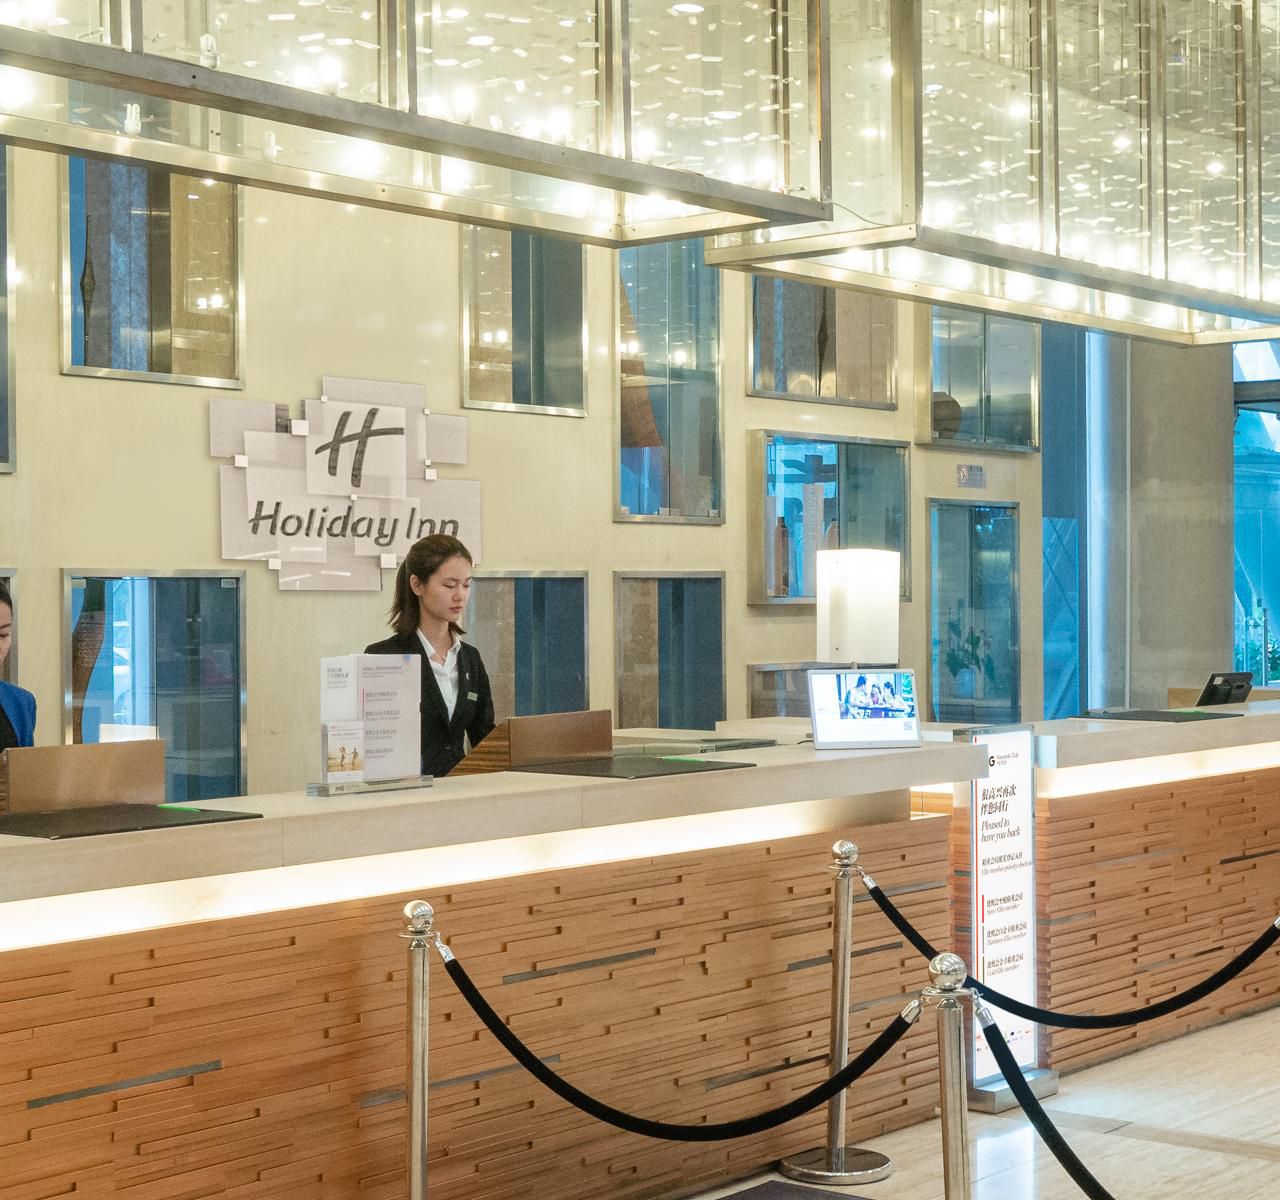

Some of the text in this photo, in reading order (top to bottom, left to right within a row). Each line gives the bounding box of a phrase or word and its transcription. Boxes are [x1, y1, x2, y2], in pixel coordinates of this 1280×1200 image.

[315, 407, 404, 488] H
[248, 500, 459, 547] Holiday Inn
[982, 784, 1016, 801] 很高兴再次
[981, 800, 1009, 815] 伴您同行
[981, 818, 1010, 831] Pleased to
[981, 826, 1021, 843] have you back
